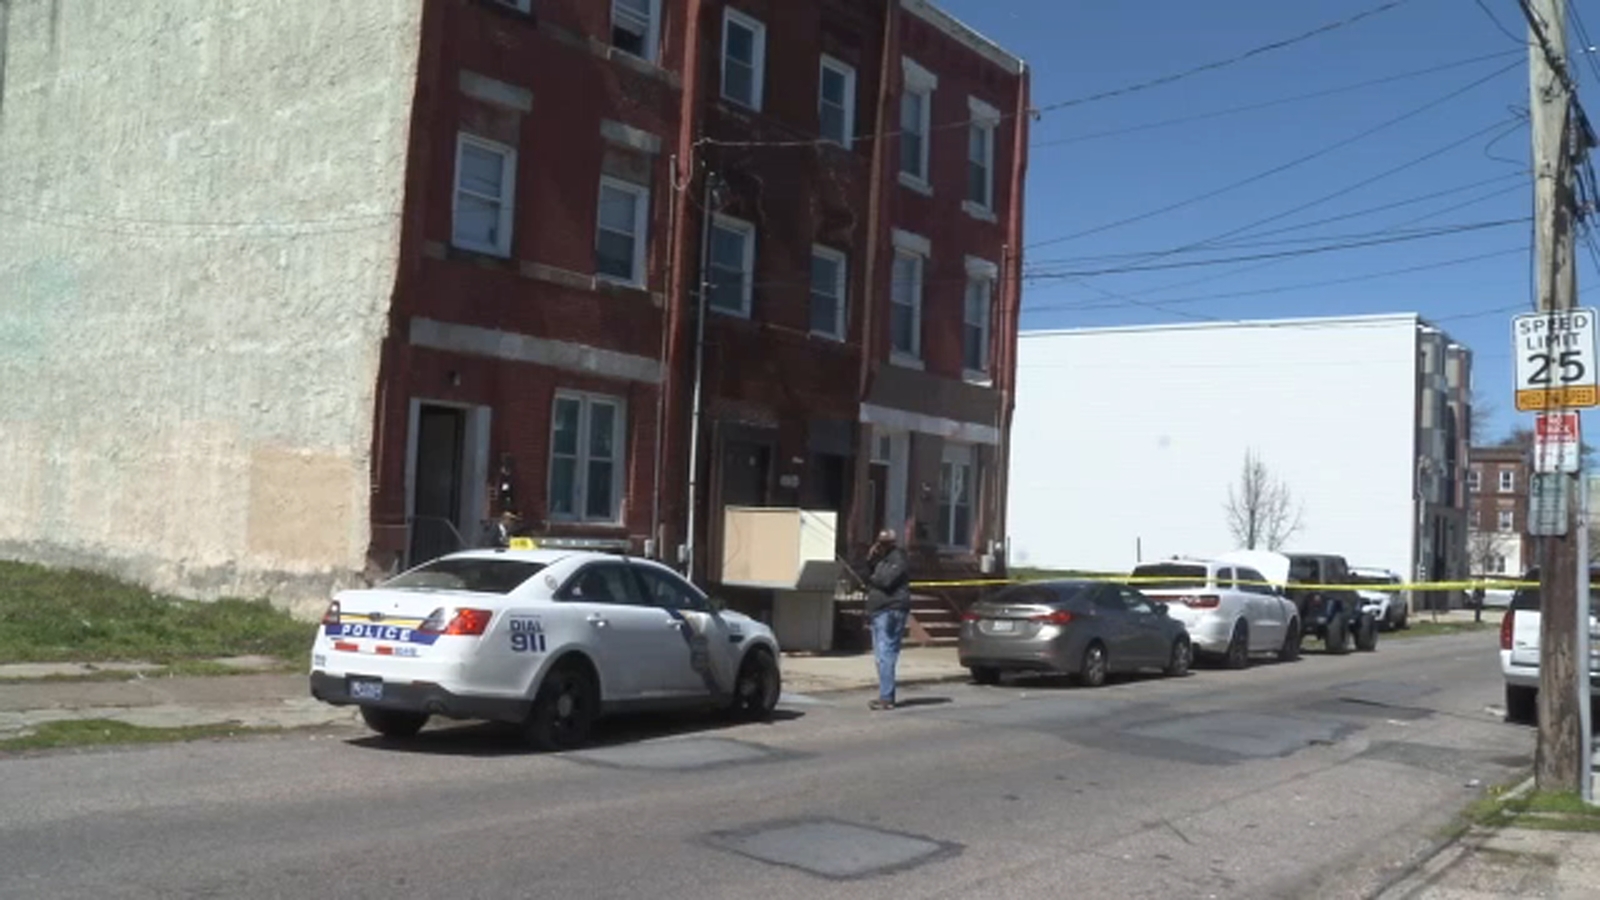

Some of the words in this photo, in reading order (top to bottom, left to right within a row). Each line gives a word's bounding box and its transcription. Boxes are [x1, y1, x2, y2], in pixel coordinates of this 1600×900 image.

[1520, 314, 1588, 335] SPEED
[1527, 332, 1580, 350] LIMIT
[1527, 351, 1585, 384] 25
[341, 625, 411, 641] POLICE
[510, 620, 543, 633] DIAL
[511, 632, 546, 652] 911
